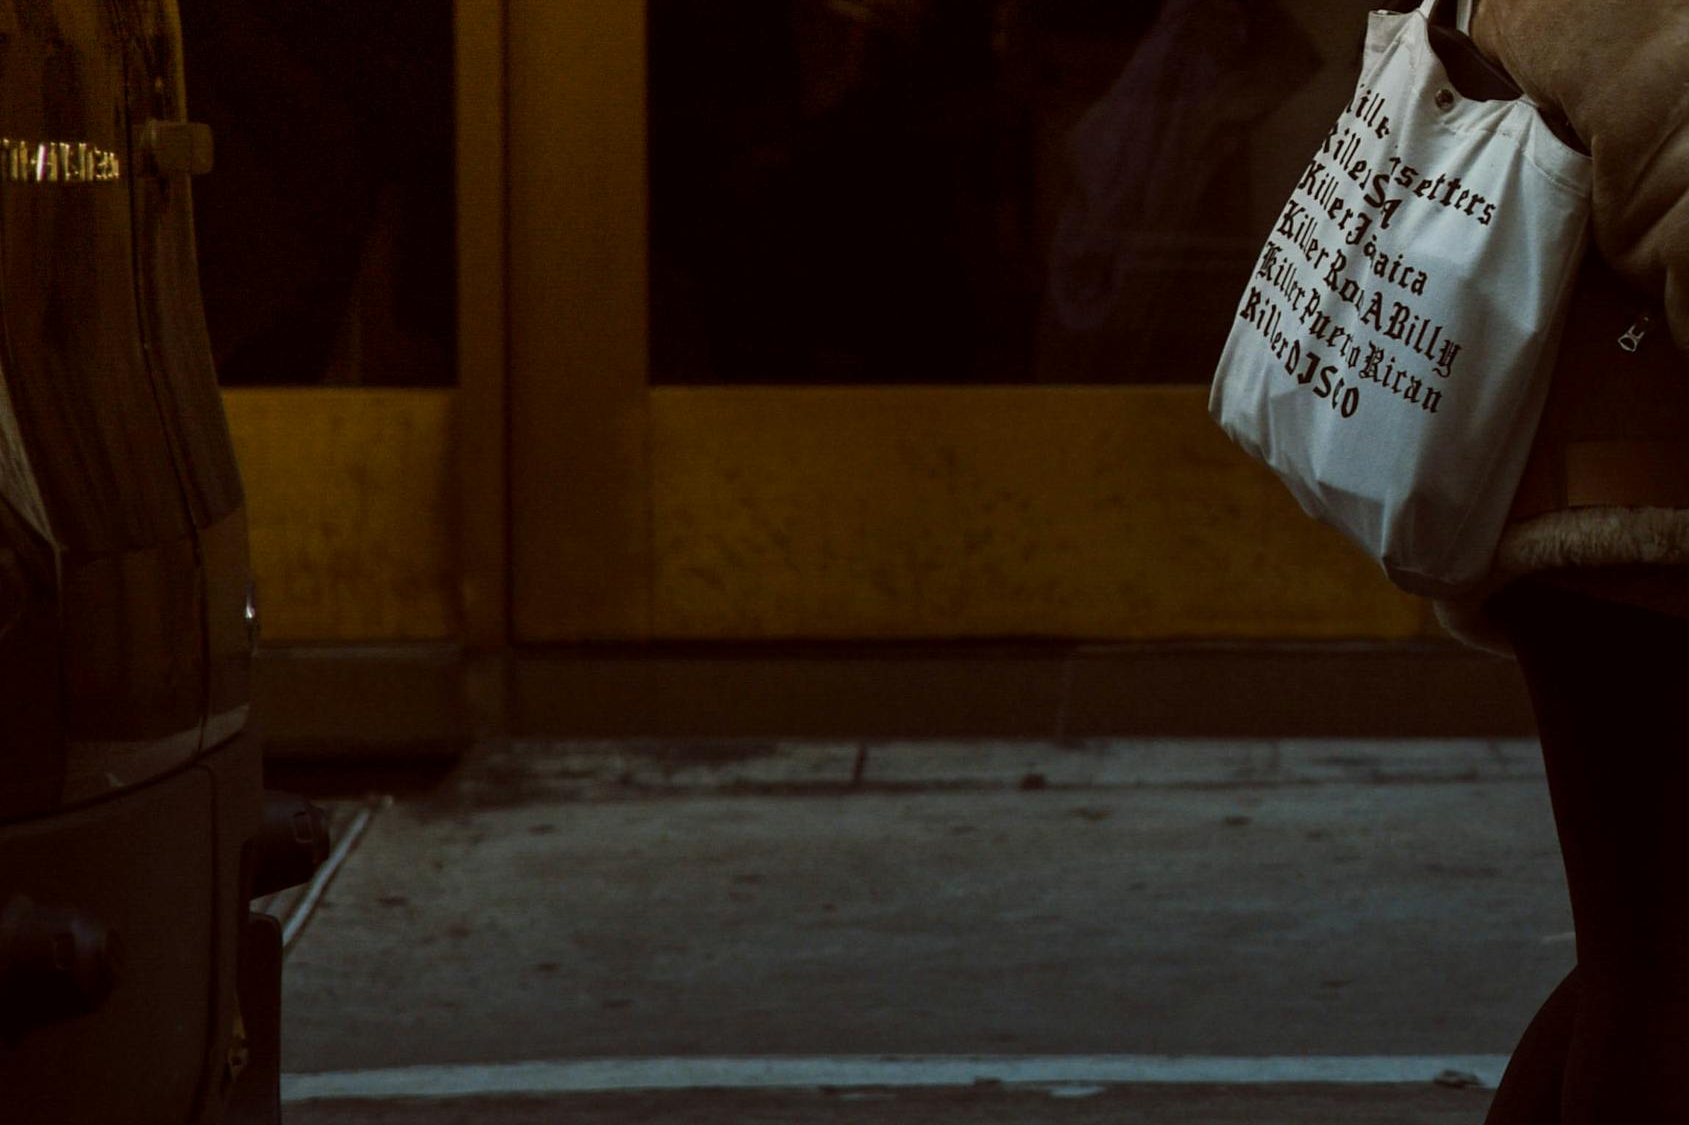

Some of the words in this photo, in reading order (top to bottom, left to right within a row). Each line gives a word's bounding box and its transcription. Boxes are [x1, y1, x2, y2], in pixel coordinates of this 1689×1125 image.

[1277, 199, 1329, 270] Killer
[1240, 286, 1289, 360] Killer
[1256, 241, 1305, 311] Killer
[1359, 340, 1442, 413] Rican
